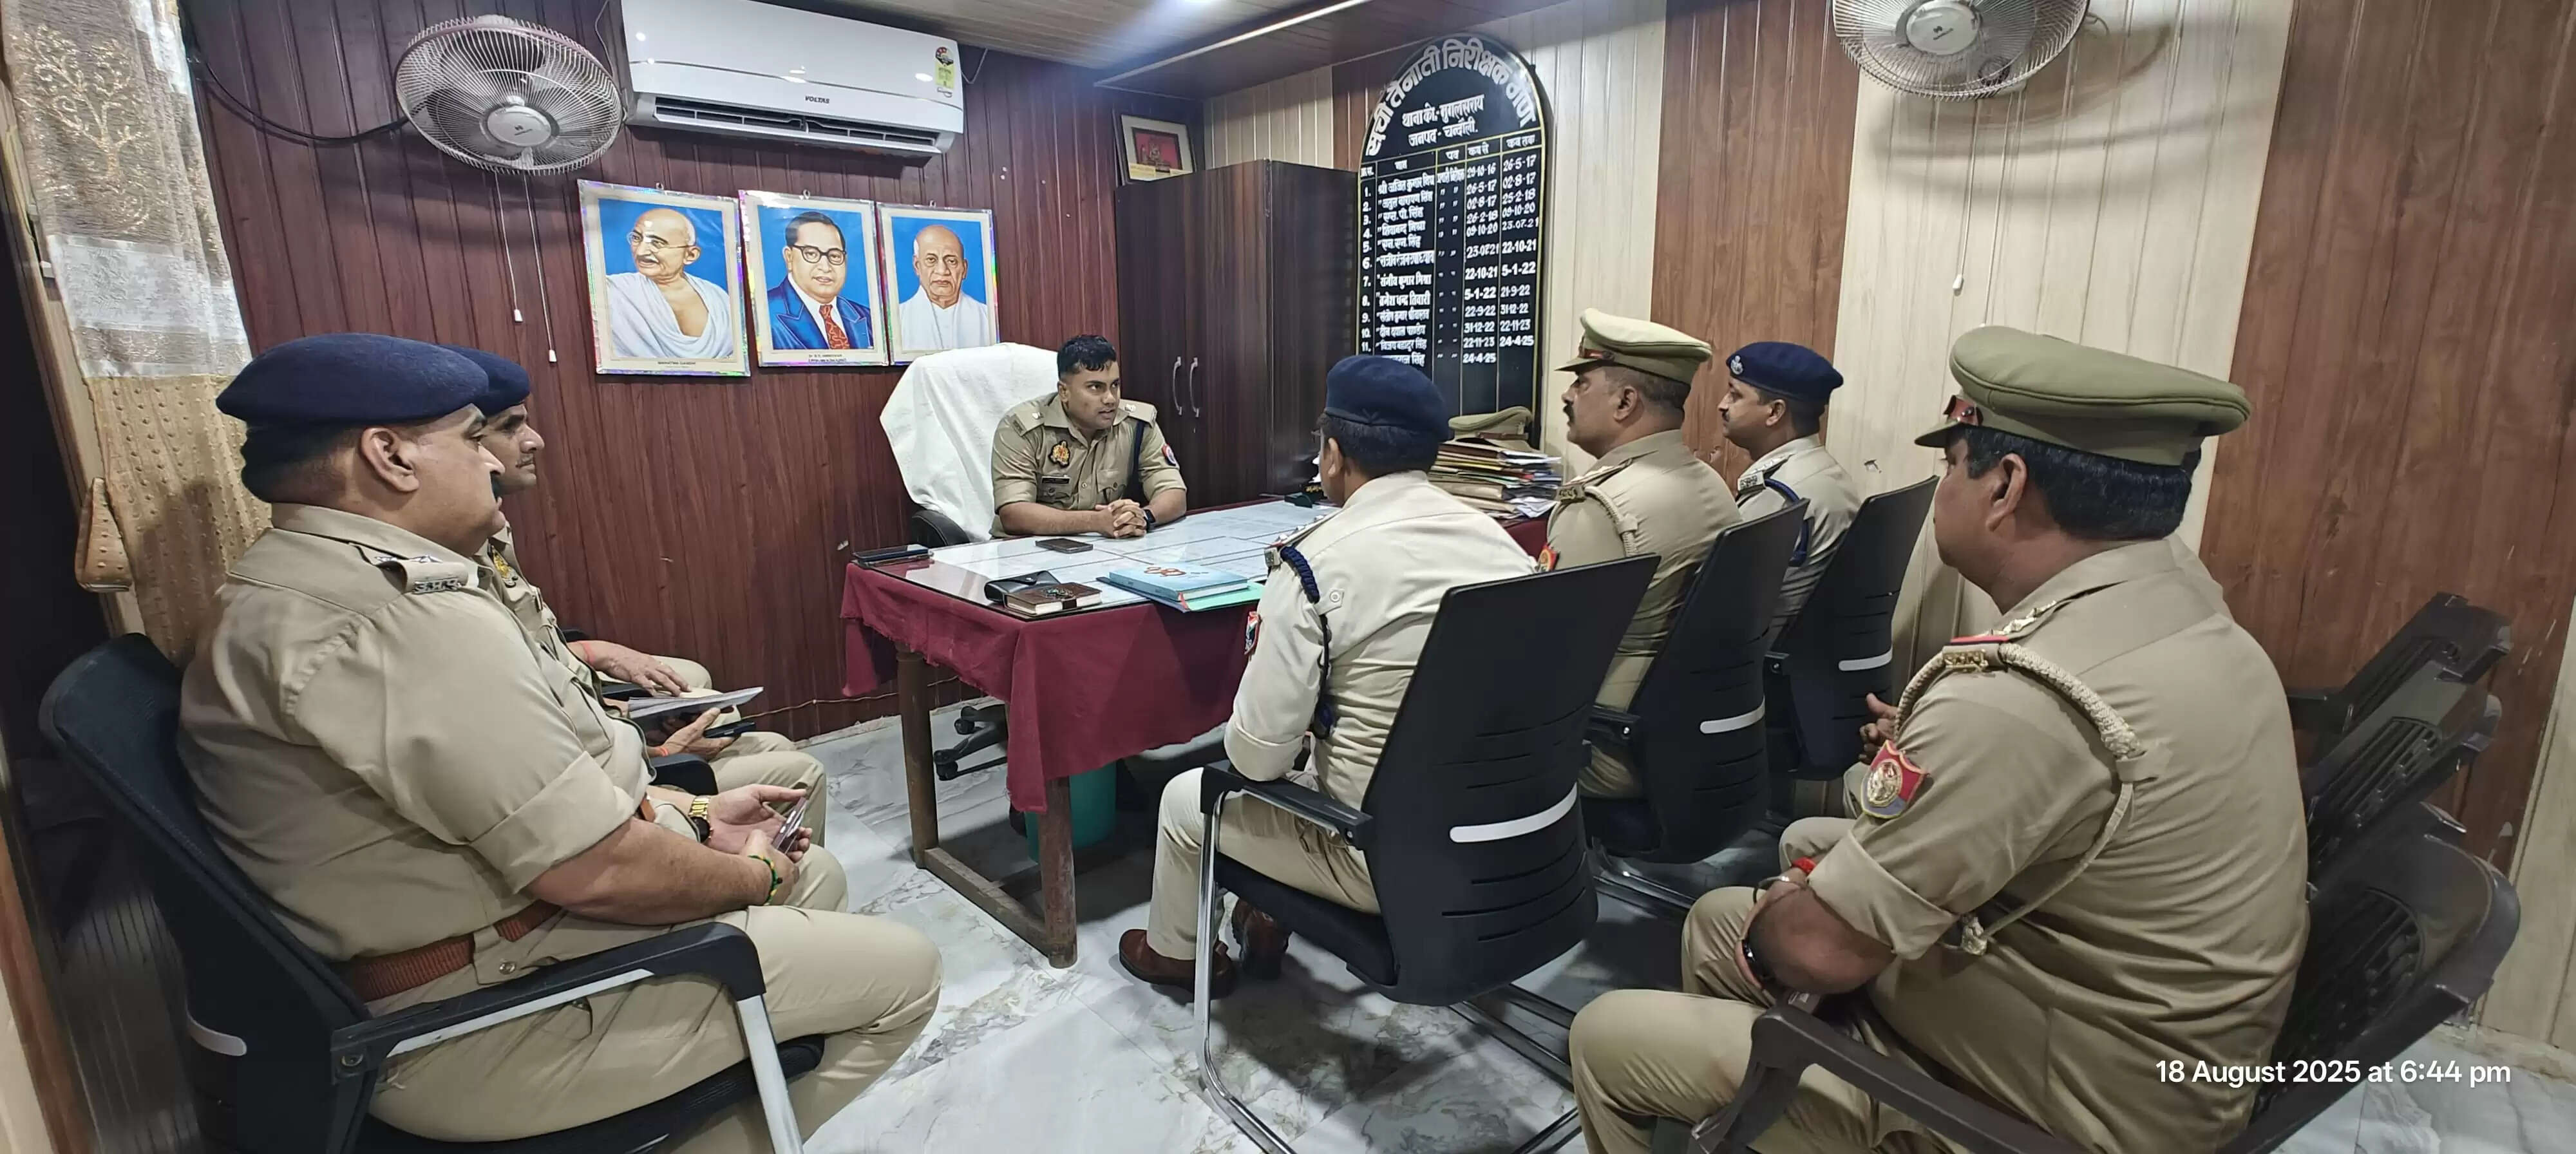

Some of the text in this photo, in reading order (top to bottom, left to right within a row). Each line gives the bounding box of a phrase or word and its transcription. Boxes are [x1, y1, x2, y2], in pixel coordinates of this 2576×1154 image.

[1442, 37, 1513, 85] निरीक्षक
[805, 95, 829, 104] VOLTAS
[1408, 129, 1437, 146] जनपद
[1502, 154, 1537, 172] 26-5-17
[1502, 172, 1536, 189] 02-8-17
[1466, 194, 1497, 210] 02-8-17
[1502, 202, 1535, 218] 09-10-20
[1502, 239, 1537, 254] 22-10-21
[1465, 266, 1498, 280] 22-10-21
[1502, 261, 1536, 276] 5-1-22
[1464, 287, 1497, 300] 5-1-22
[1464, 305, 1496, 317] 22-9-22
[1499, 335, 1535, 347] 24-4-25
[1463, 353, 1497, 364] 24-4-25
